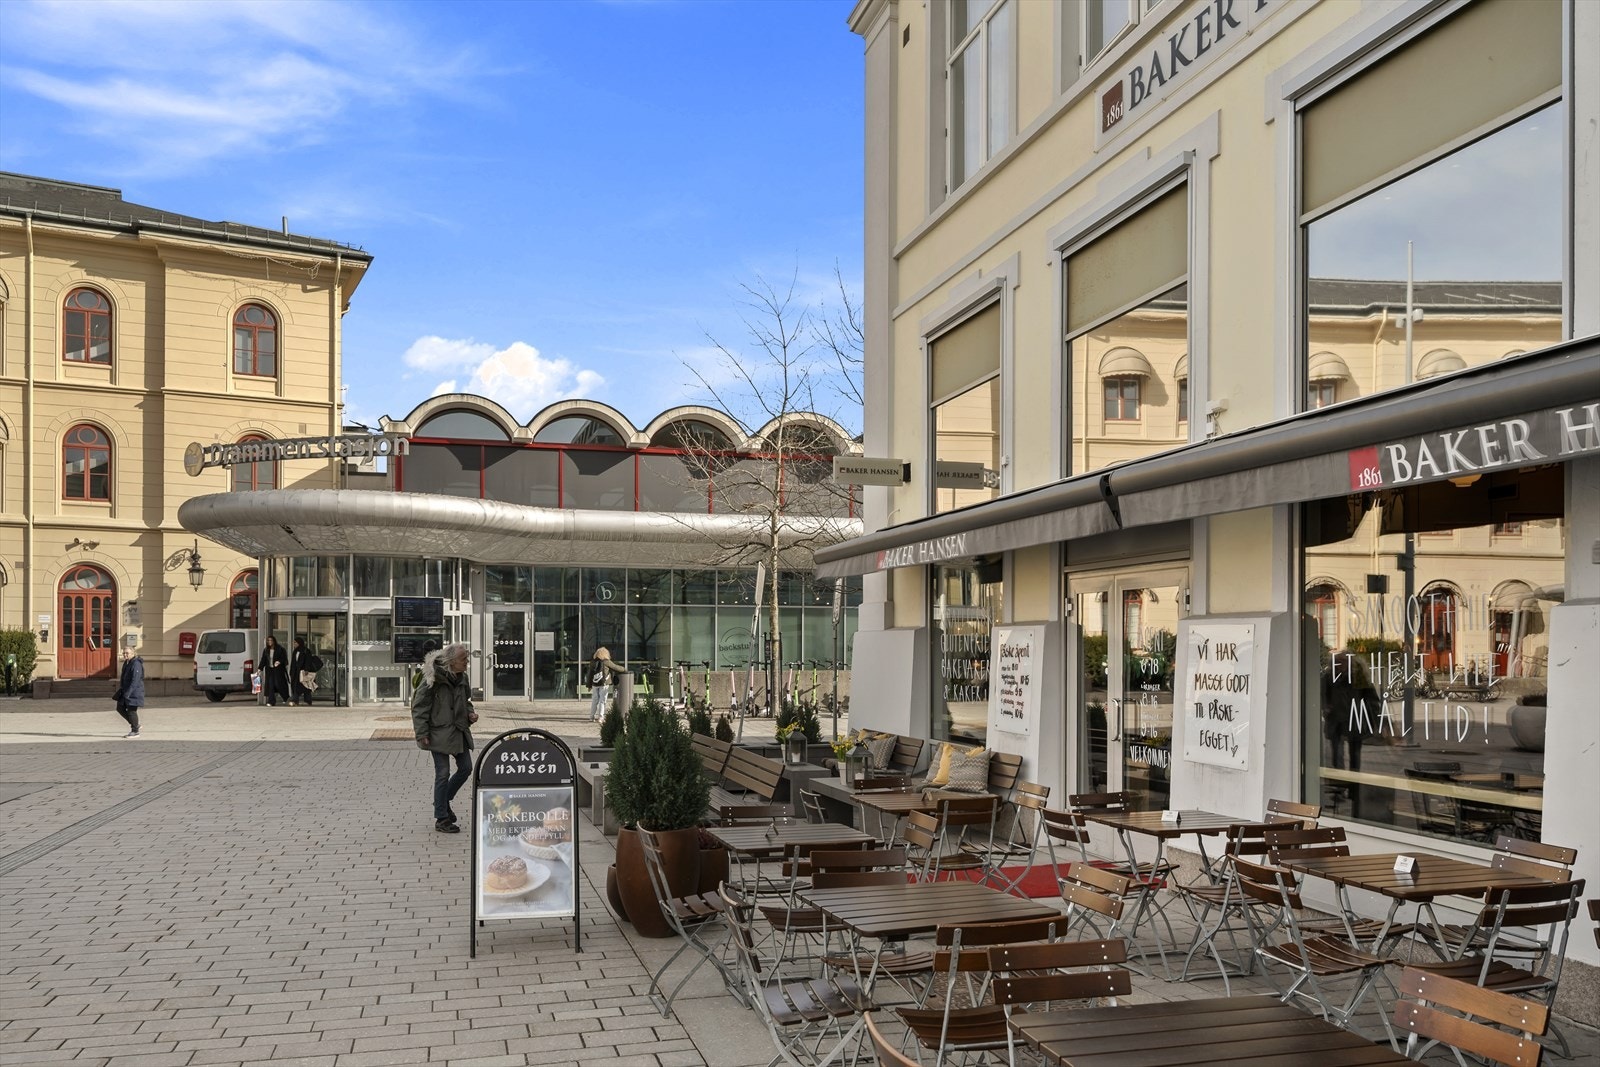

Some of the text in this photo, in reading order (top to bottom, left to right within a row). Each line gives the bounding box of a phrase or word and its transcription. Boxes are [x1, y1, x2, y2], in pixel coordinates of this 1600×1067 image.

[1106, 0, 1241, 128] 1861 BAKER
[210, 433, 410, 466] Drammen stasjon
[1358, 466, 1383, 487] 1861
[1385, 419, 1547, 484] BAKER
[870, 468, 899, 476] HANSEN
[882, 532, 969, 569] BAKER HANSEN
[1347, 592, 1496, 636] SMOOTHIE
[718, 641, 759, 652] backstue
[1215, 642, 1239, 662] HAR
[1194, 672, 1250, 695] MASSE GODT
[1331, 652, 1356, 684] ET
[1369, 651, 1430, 685] HELT
[488, 827, 507, 835] MED
